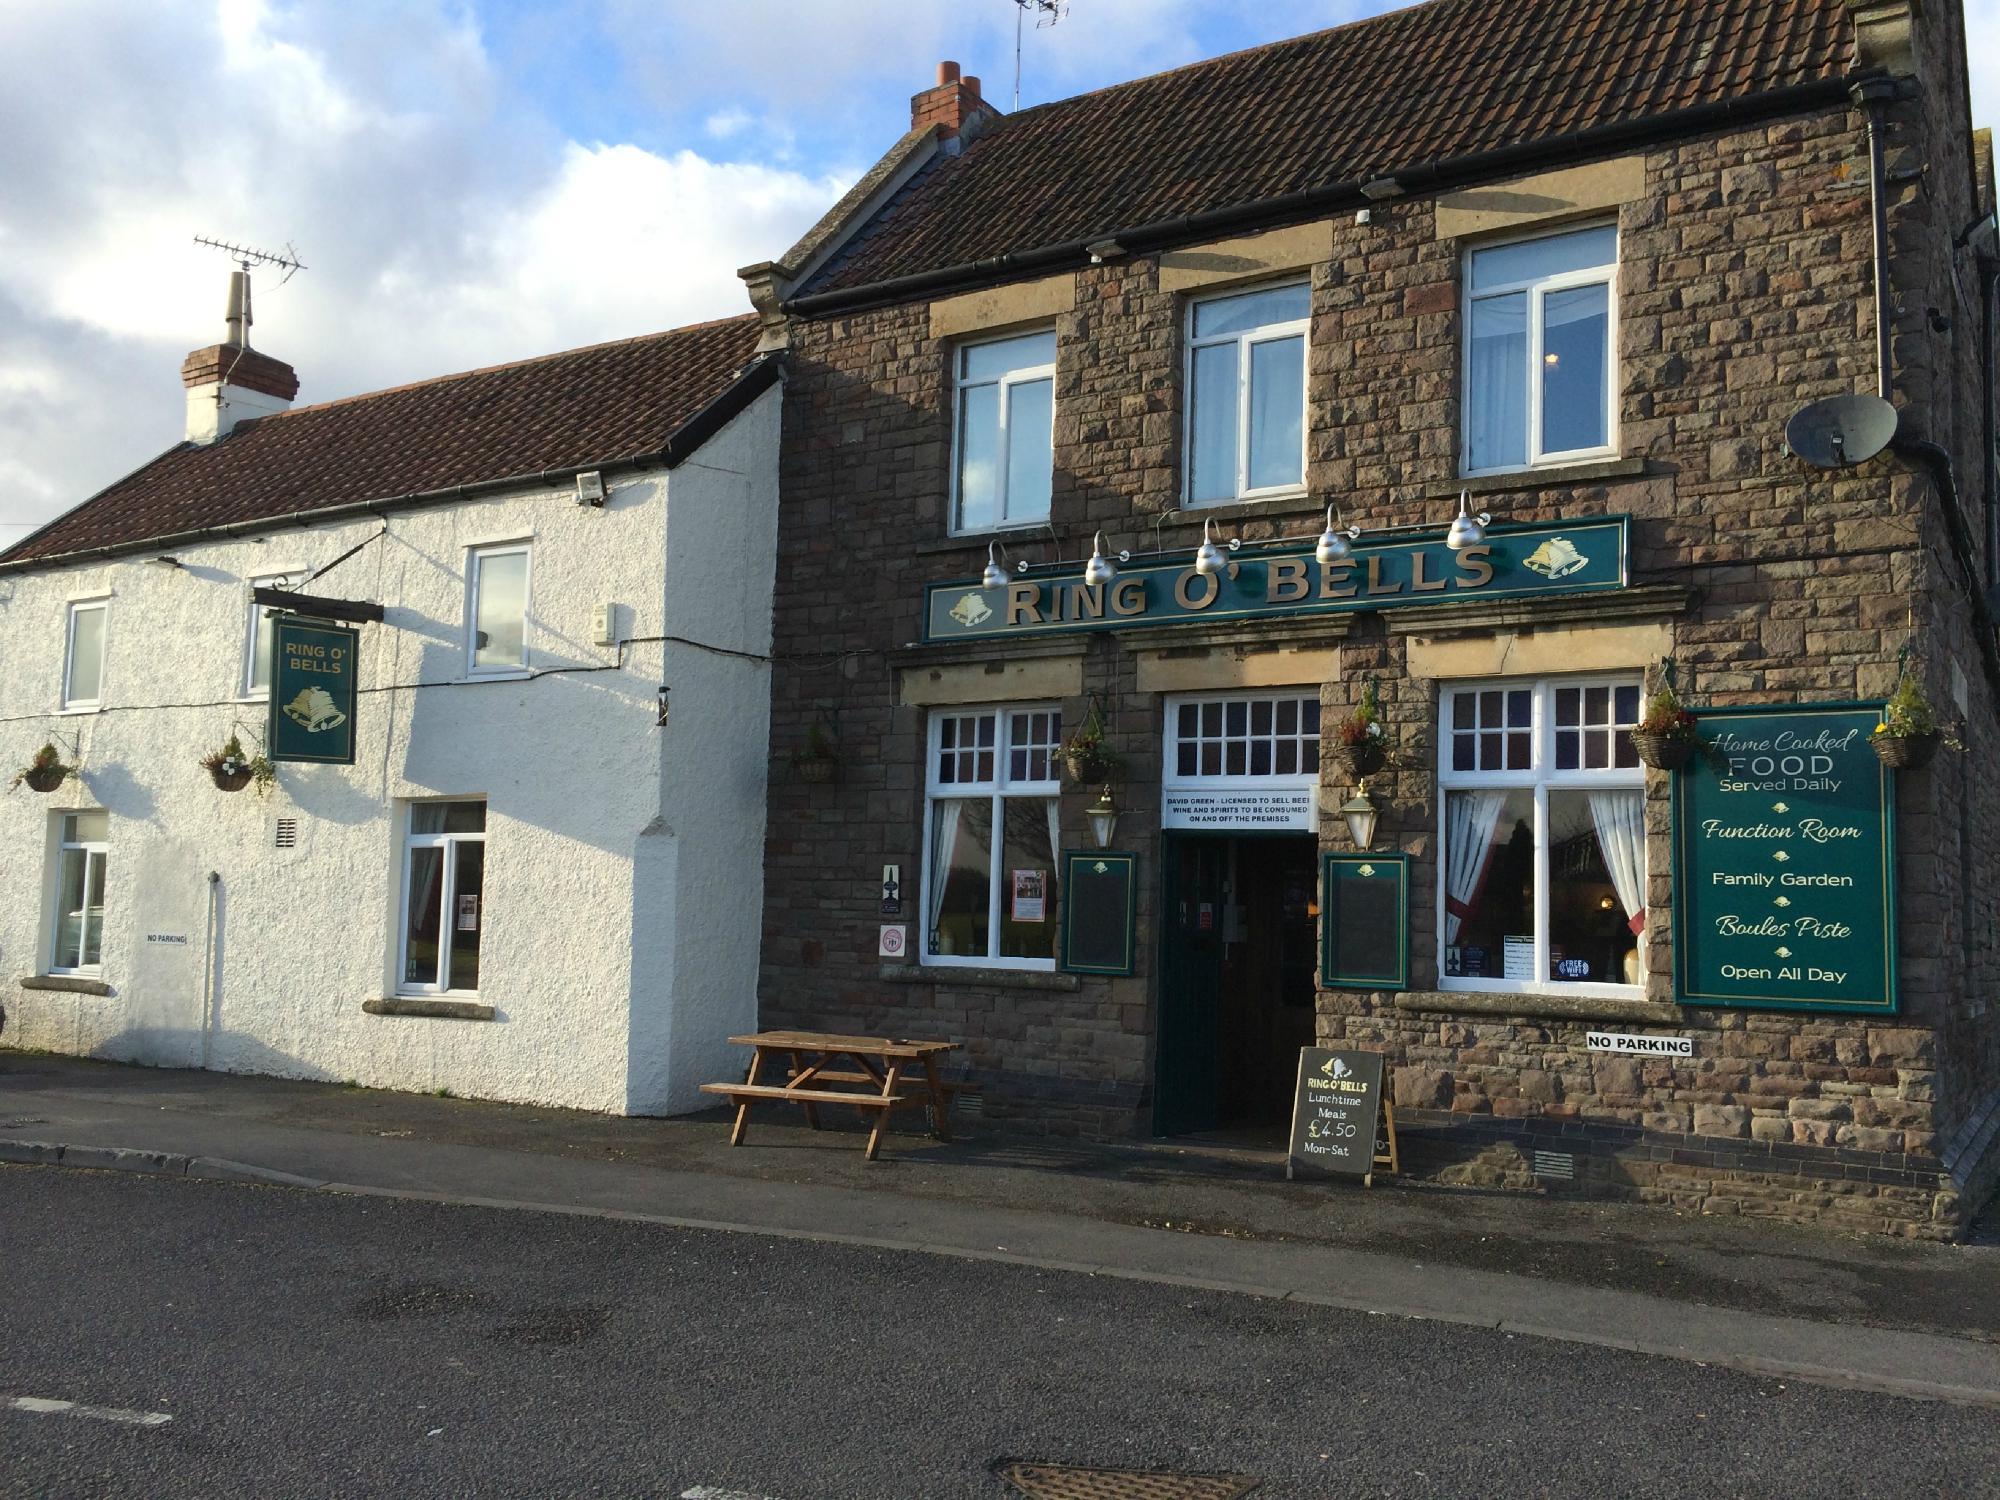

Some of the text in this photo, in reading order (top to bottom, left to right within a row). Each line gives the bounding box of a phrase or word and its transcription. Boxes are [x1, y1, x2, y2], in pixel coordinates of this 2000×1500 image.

[1007, 544, 1494, 625] RING O' BELLS
[286, 643, 346, 659] RING O'
[290, 657, 341, 673] BELLS
[1709, 728, 1858, 753] Home Cooked
[1727, 755, 1834, 777] FOOD
[1719, 778, 1842, 793] Served Daily
[1701, 818, 1862, 844] Function Room
[1712, 872, 1853, 888] Family Garden
[1715, 915, 1852, 939] Boules Piste
[157, 935, 185, 943] PARKING
[1720, 964, 1848, 984] Open All Day
[1588, 1036, 1691, 1053] NO PARKING
[1308, 1091, 1361, 1106] Lunchtime
[1318, 1107, 1347, 1119] Meals
[1308, 1119, 1357, 1138] £4.50
[1304, 1141, 1350, 1157] Mon-Sat
